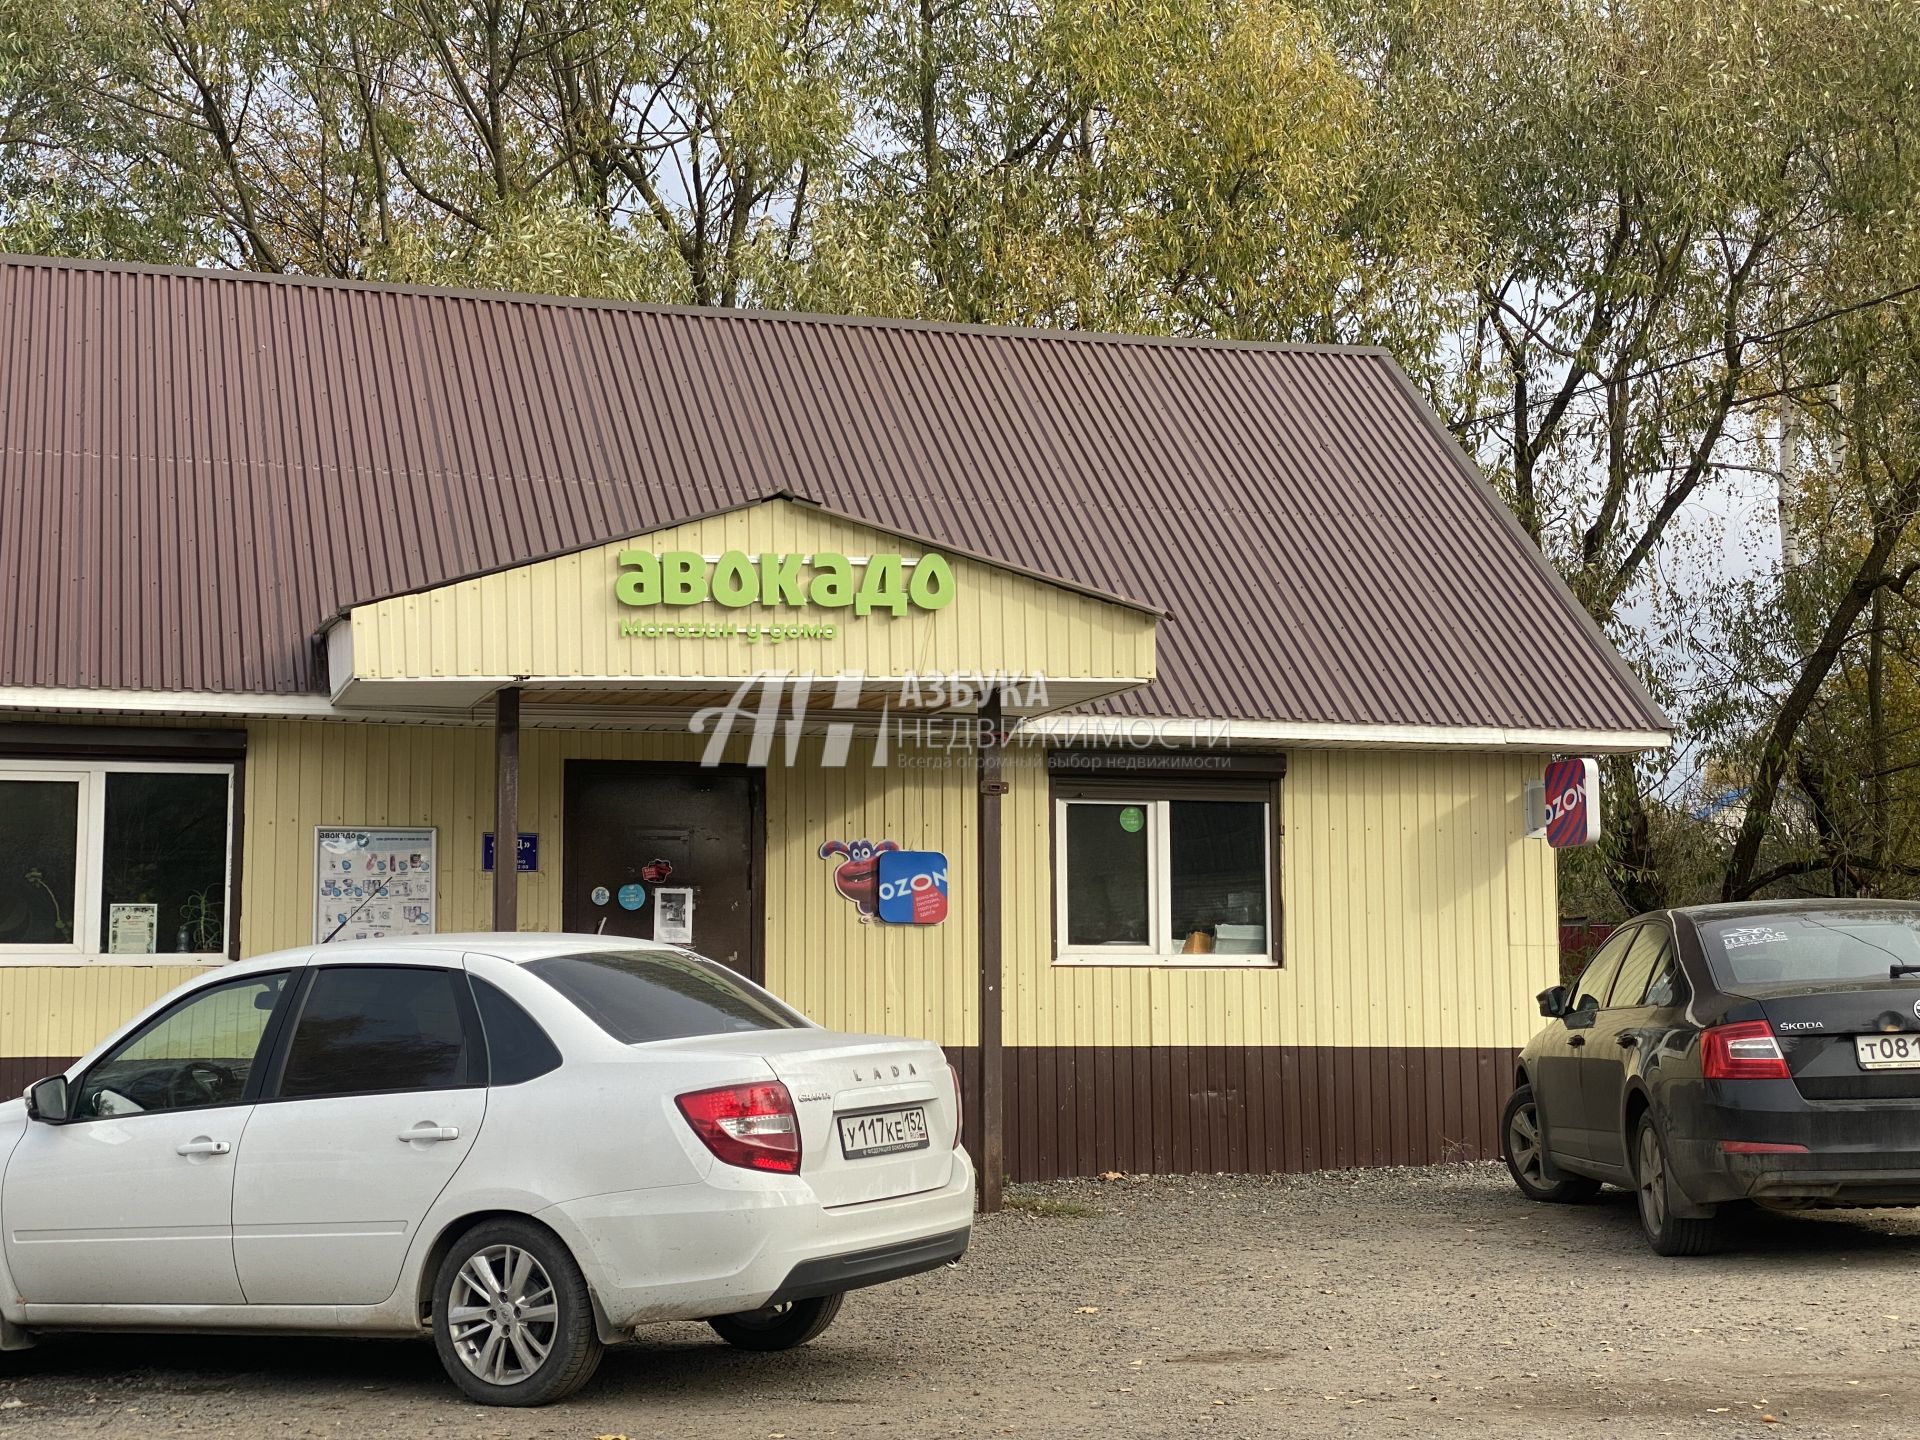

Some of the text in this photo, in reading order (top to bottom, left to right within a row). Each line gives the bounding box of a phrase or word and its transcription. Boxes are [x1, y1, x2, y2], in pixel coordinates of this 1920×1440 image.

[615, 550, 956, 617] авокадо
[620, 617, 838, 643] Магазин у дома
[1545, 779, 1587, 826] OZON
[879, 868, 948, 900] OZON
[1779, 1021, 1825, 1031] ŠKODA
[853, 1063, 917, 1081] LADA
